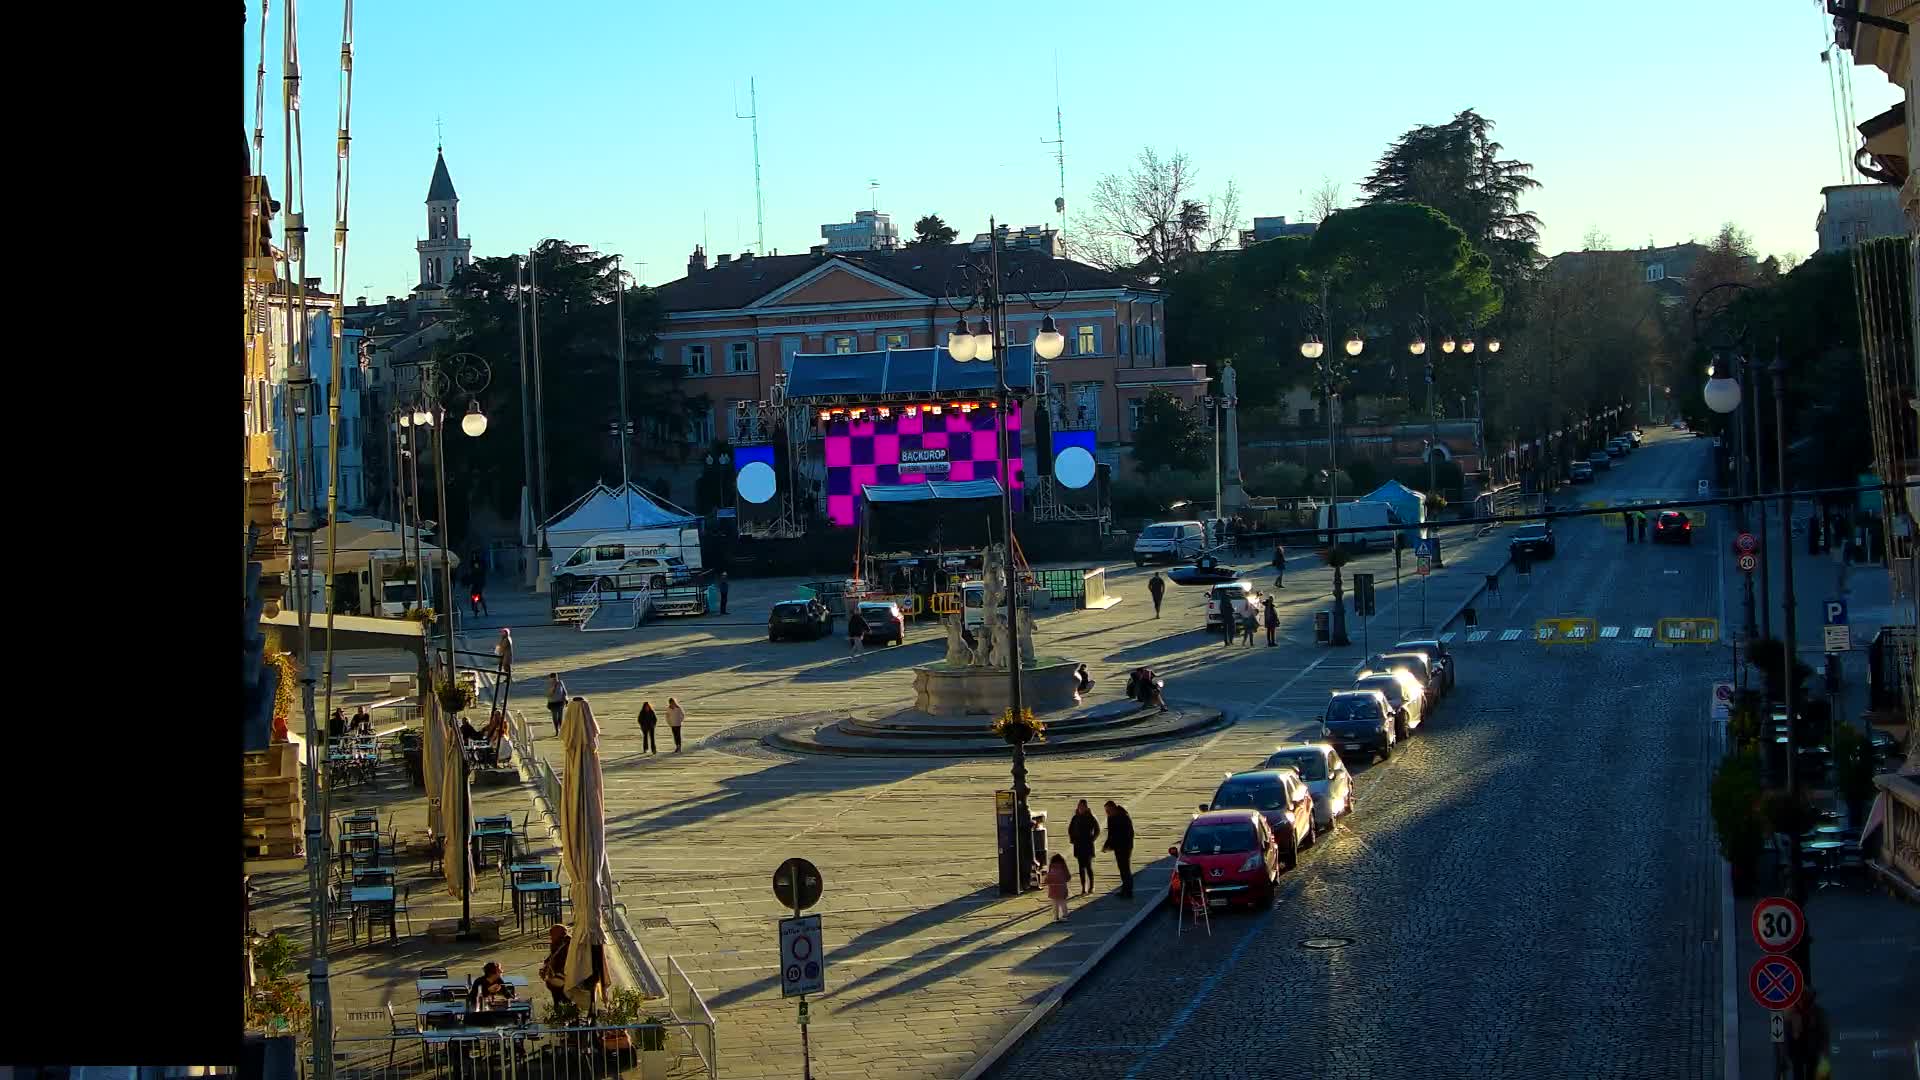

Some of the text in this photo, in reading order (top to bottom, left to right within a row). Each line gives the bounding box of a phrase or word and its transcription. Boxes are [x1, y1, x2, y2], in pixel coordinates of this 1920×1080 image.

[902, 449, 946, 461] BACKDROP
[1742, 558, 1753, 568] 20
[1827, 602, 1842, 622] P
[1763, 912, 1792, 938] 30
